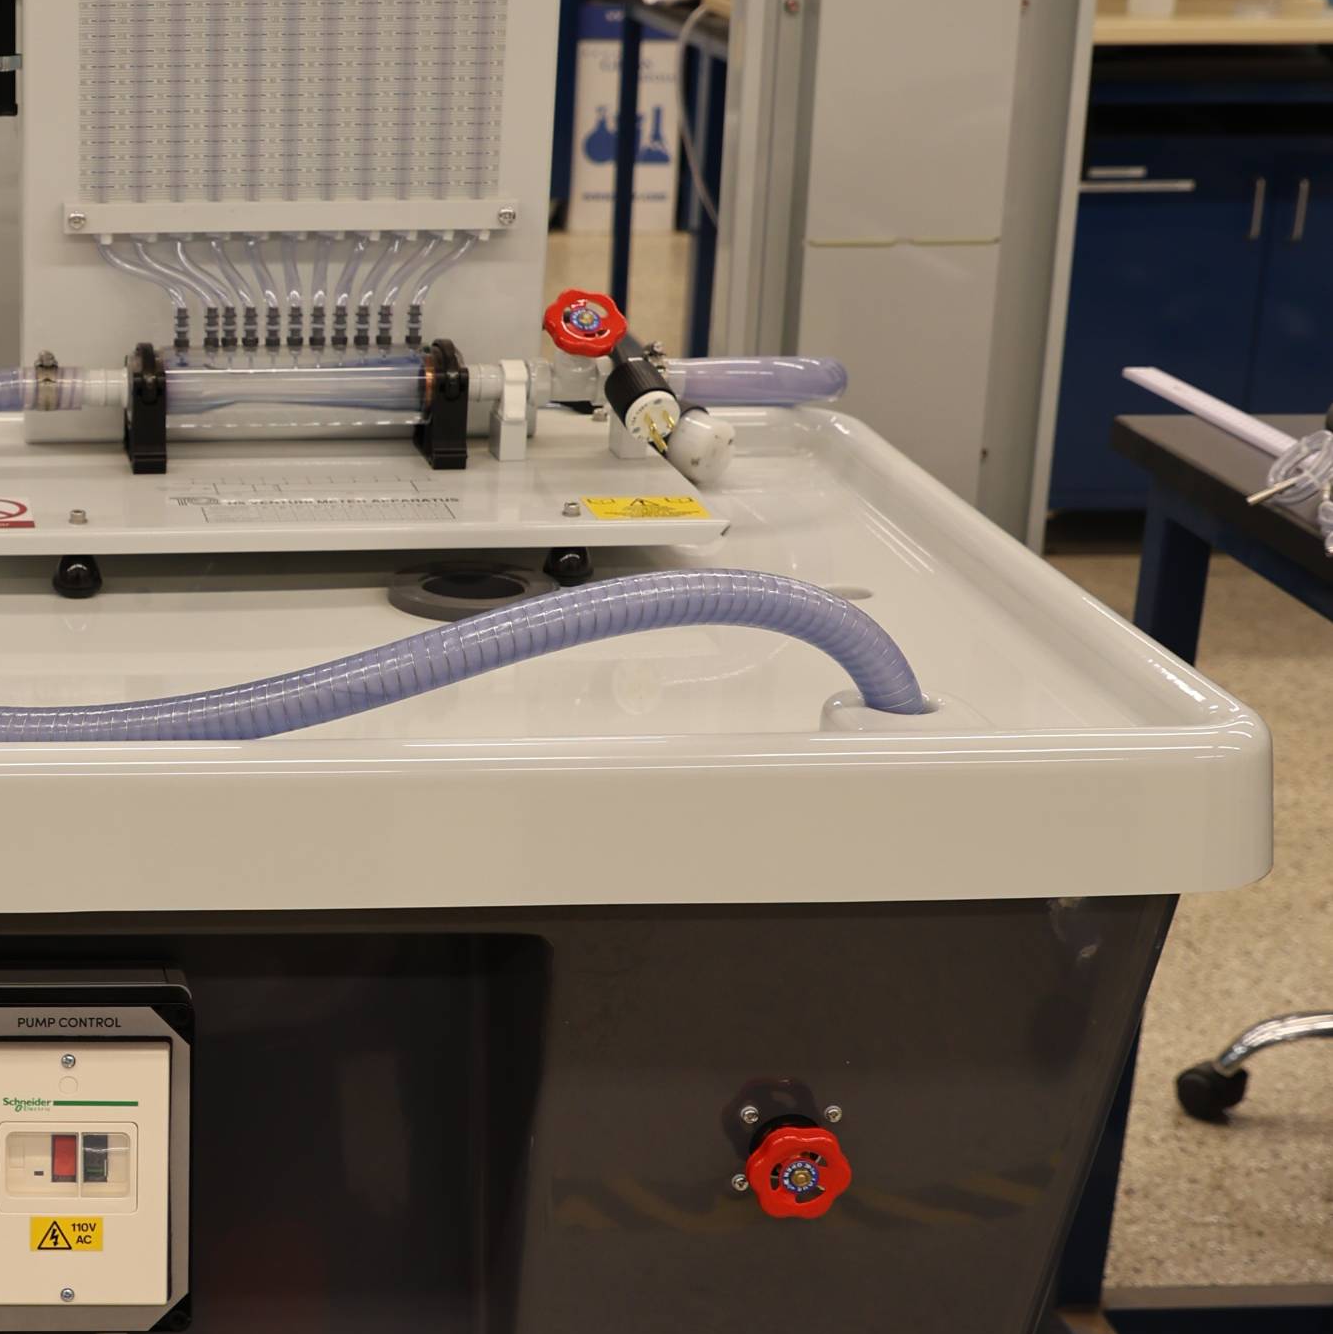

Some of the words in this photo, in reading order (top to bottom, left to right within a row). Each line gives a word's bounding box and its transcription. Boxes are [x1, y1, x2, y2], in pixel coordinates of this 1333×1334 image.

[17, 1017, 55, 1028] PUMP
[58, 1017, 122, 1028] CONTROL
[2, 1097, 52, 1110] Schneider
[71, 1222, 97, 1234] 110V
[76, 1235, 92, 1245] AC
